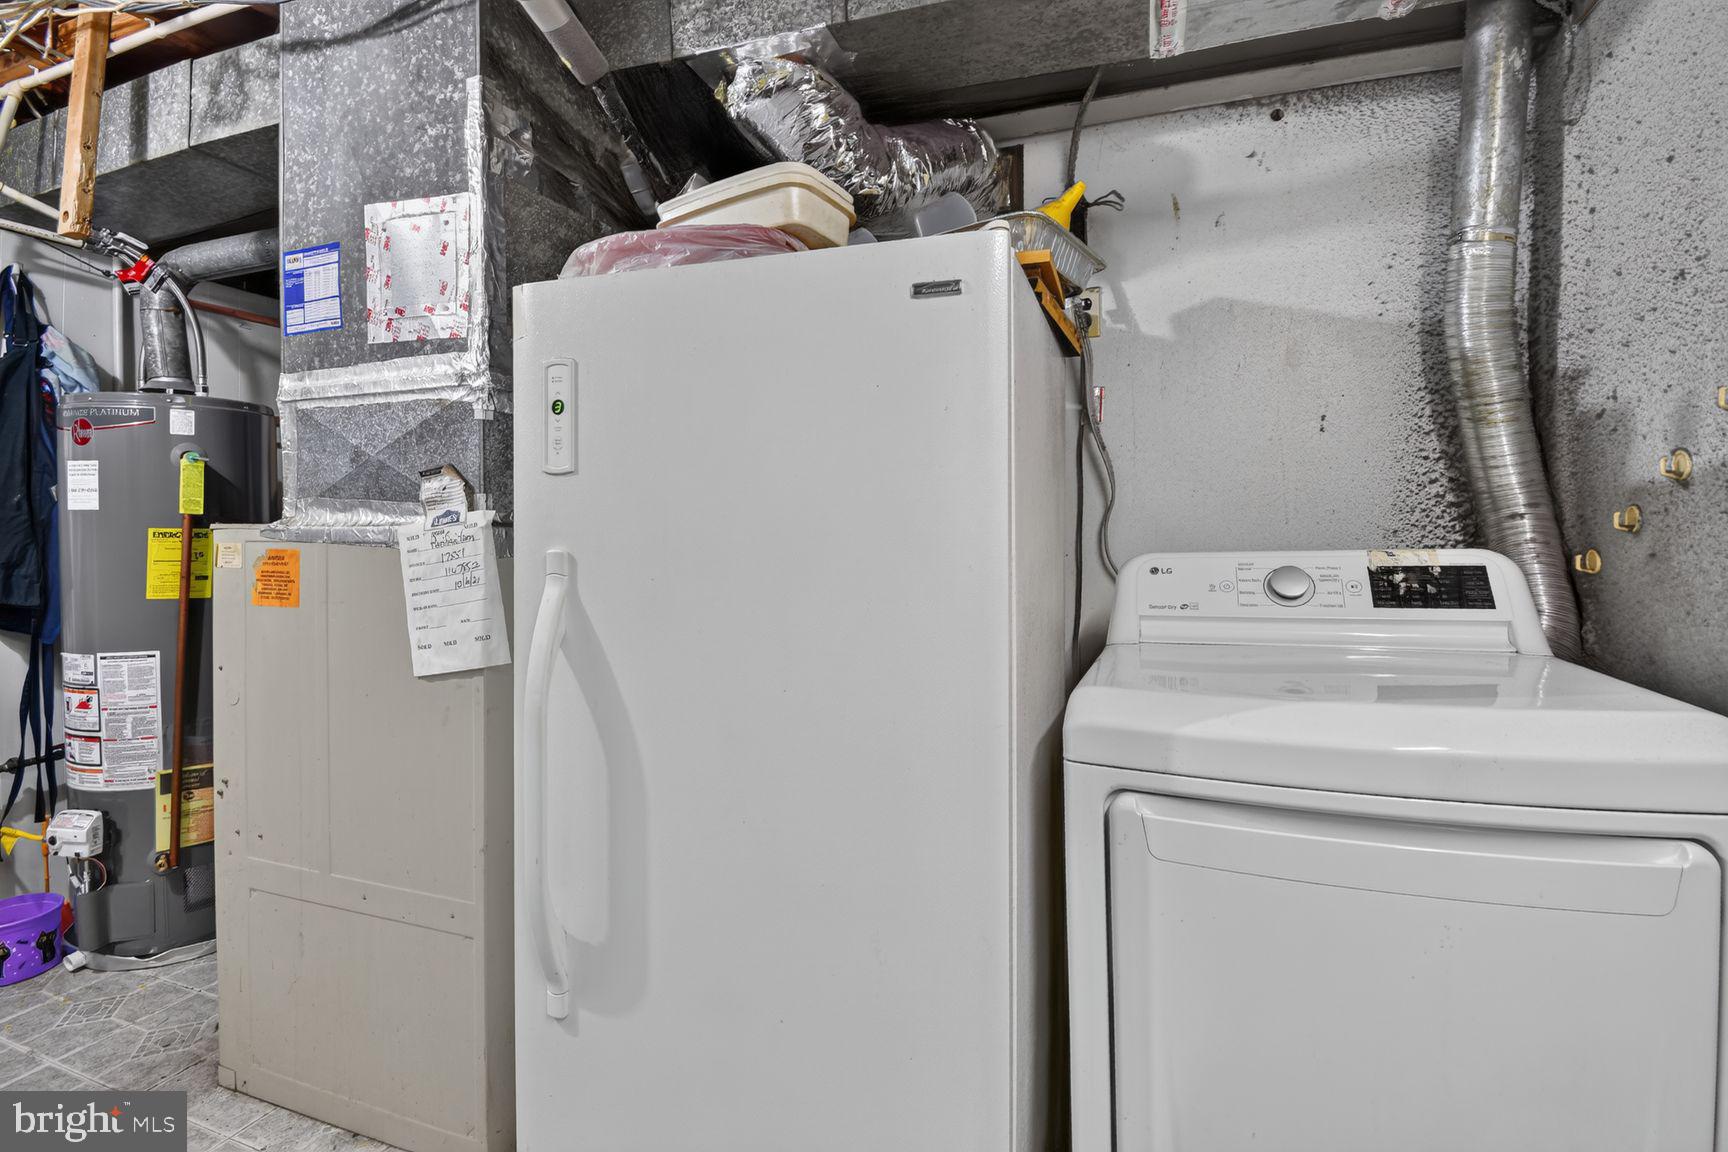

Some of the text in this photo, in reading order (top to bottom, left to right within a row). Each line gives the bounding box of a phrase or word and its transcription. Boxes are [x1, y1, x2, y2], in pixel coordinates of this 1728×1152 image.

[554, 401, 562, 413] 3
[89, 408, 140, 417] PLATINUM
[1160, 567, 1173, 575] LG
[1167, 603, 1177, 611] Dry
